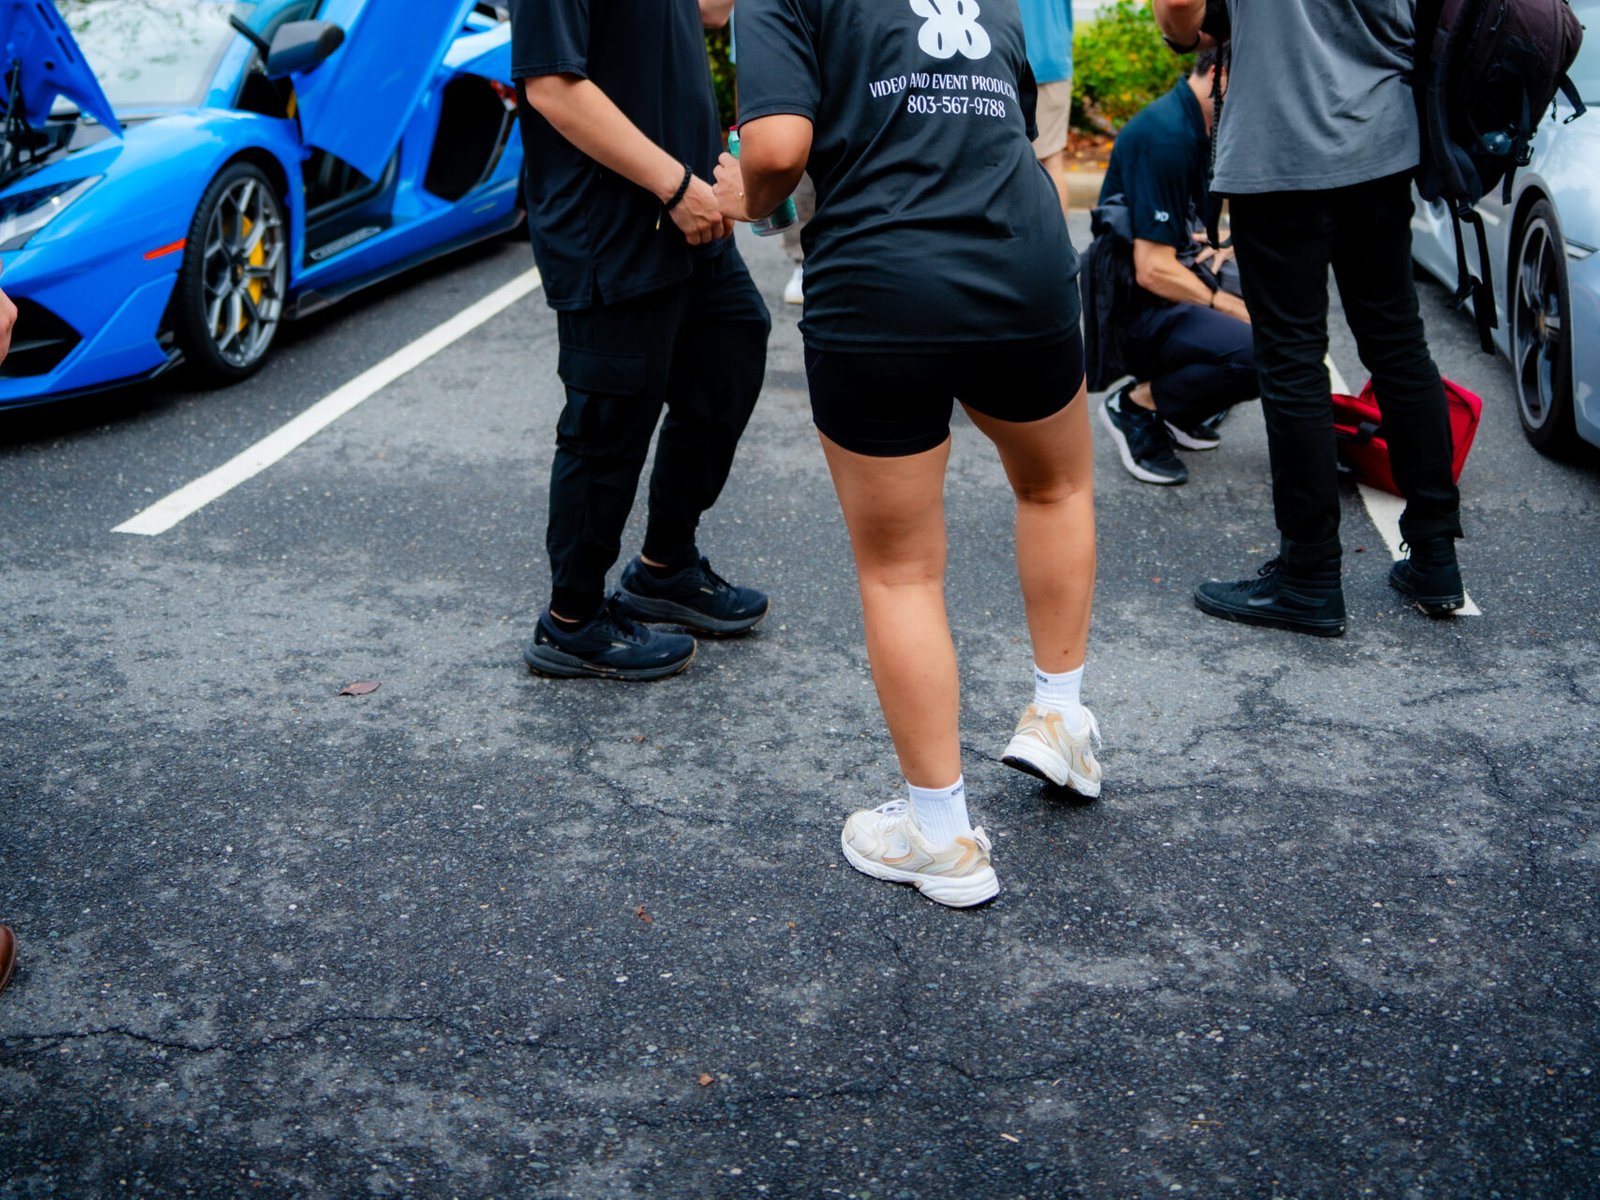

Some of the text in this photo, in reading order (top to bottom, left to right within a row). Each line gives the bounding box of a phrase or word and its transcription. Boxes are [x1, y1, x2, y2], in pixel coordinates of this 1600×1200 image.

[869, 75, 907, 98] VIDEO
[909, 72, 930, 89] AND
[932, 73, 968, 90] EVENT
[907, 94, 1006, 118] 803-567-9788
